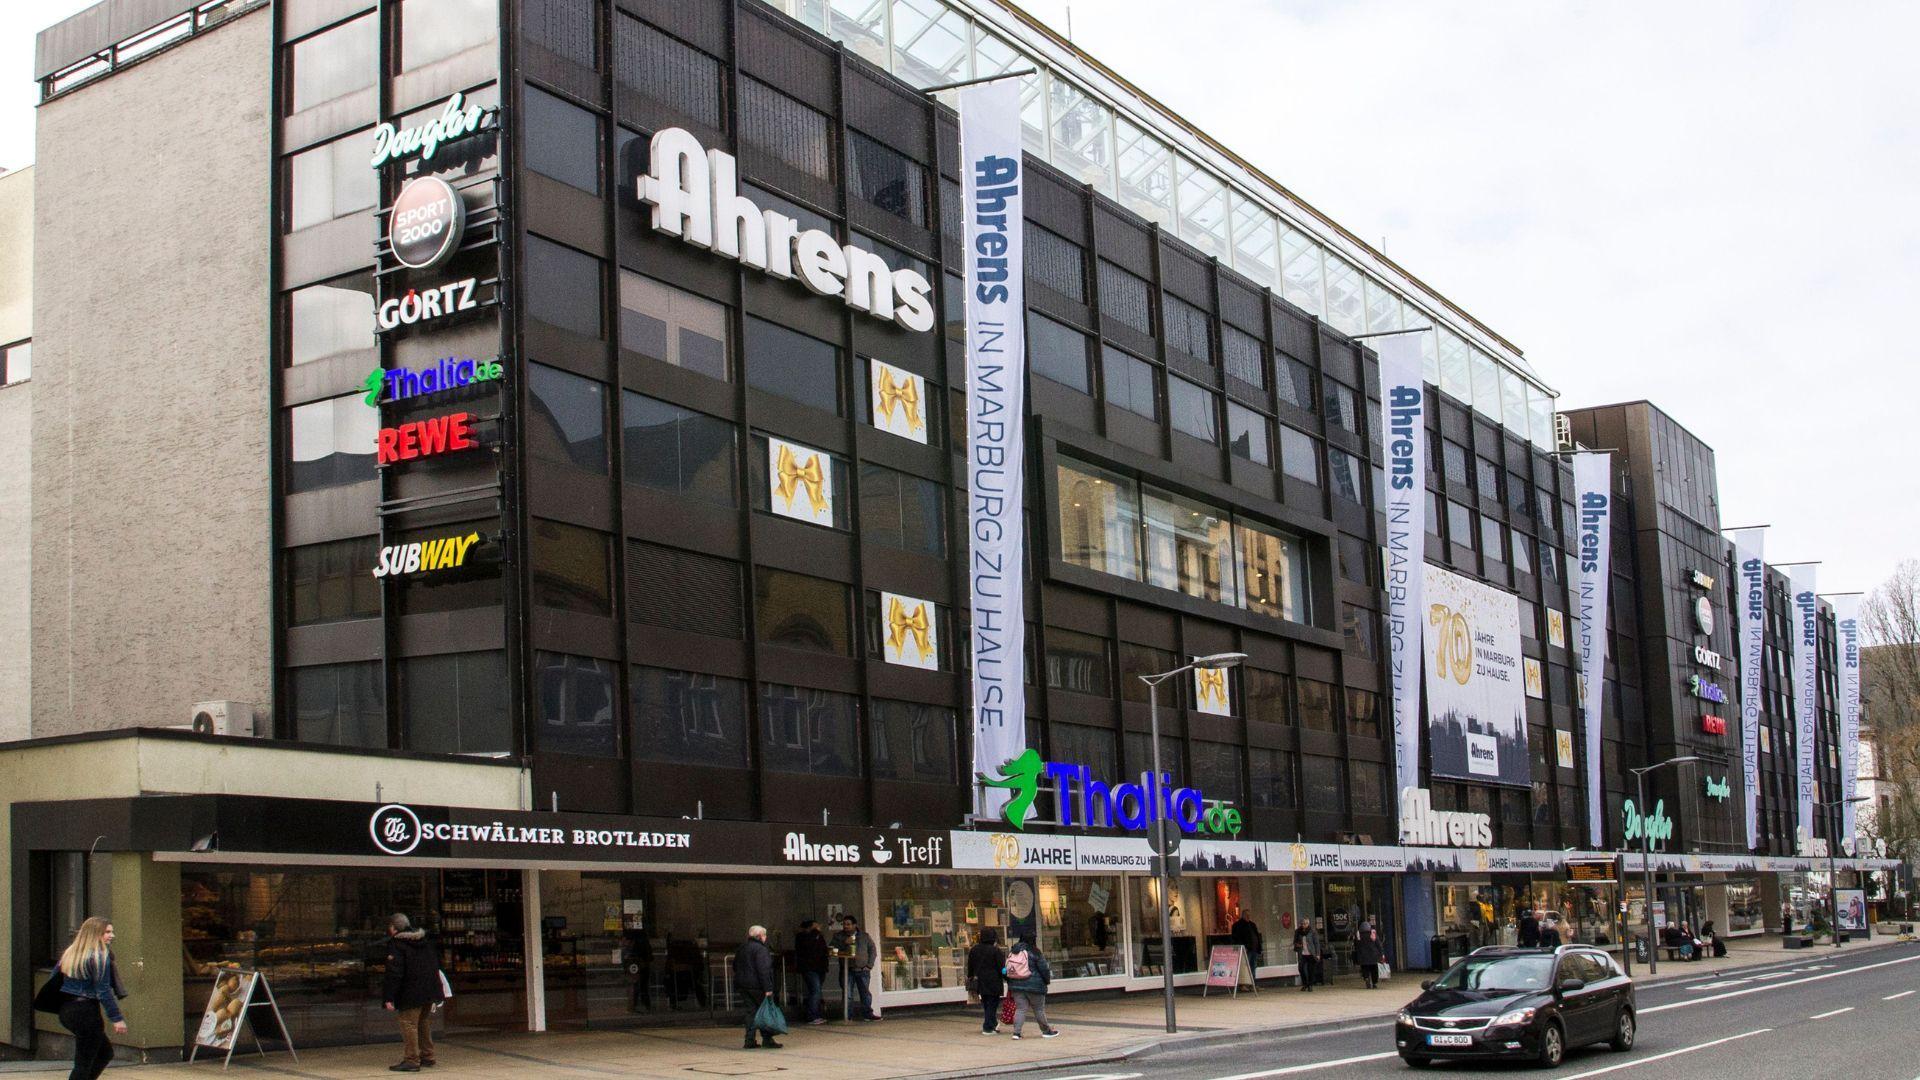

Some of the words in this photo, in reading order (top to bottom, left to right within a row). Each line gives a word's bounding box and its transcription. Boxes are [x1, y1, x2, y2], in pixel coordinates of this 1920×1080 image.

[371, 92, 484, 168] Douglas
[396, 199, 447, 228] SPORT
[400, 219, 442, 245] 2000
[637, 127, 935, 332] Ahrens
[975, 155, 1019, 305] Ahrens
[978, 321, 1004, 353] IN
[385, 357, 503, 401] Thalia.de
[378, 412, 480, 465] REWE
[974, 365, 1005, 543] MARBURG
[1389, 385, 1421, 490] Ahrens
[1390, 502, 1410, 524] IN
[1582, 491, 1607, 574] Ahrens
[373, 531, 480, 578] SUBWAY
[975, 550, 1002, 598] ZU
[1389, 531, 1409, 652] MARBURG
[1581, 582, 1594, 600] IN
[1430, 603, 1472, 685] 70
[1474, 630, 1495, 646] JAHRE
[1475, 647, 1482, 658] IN
[1484, 649, 1515, 667] MARBURG
[976, 608, 1003, 733] HAUSE.
[1476, 663, 1486, 676] ZU
[1487, 665, 1510, 682] HAUSE.
[1471, 742, 1494, 760] Ahrens
[1046, 762, 1241, 834] Thalia.de
[1402, 786, 1493, 847] Ahrens
[421, 822, 565, 845] SCHWÄLMER
[572, 829, 690, 848] BROTLADEN
[783, 832, 861, 863] Ahrens
[898, 837, 943, 865] Treff
[990, 834, 1020, 869] 70
[1024, 848, 1072, 865] JAHRE
[1081, 855, 1090, 865] IN
[1092, 855, 1135, 866] MARBURG
[1136, 856, 1146, 866] ZU
[1310, 854, 1339, 867] JAHRE
[1350, 860, 1377, 868] MARBURG
[1489, 857, 1509, 869] JAHRE
[1333, 913, 1348, 921] 150€
